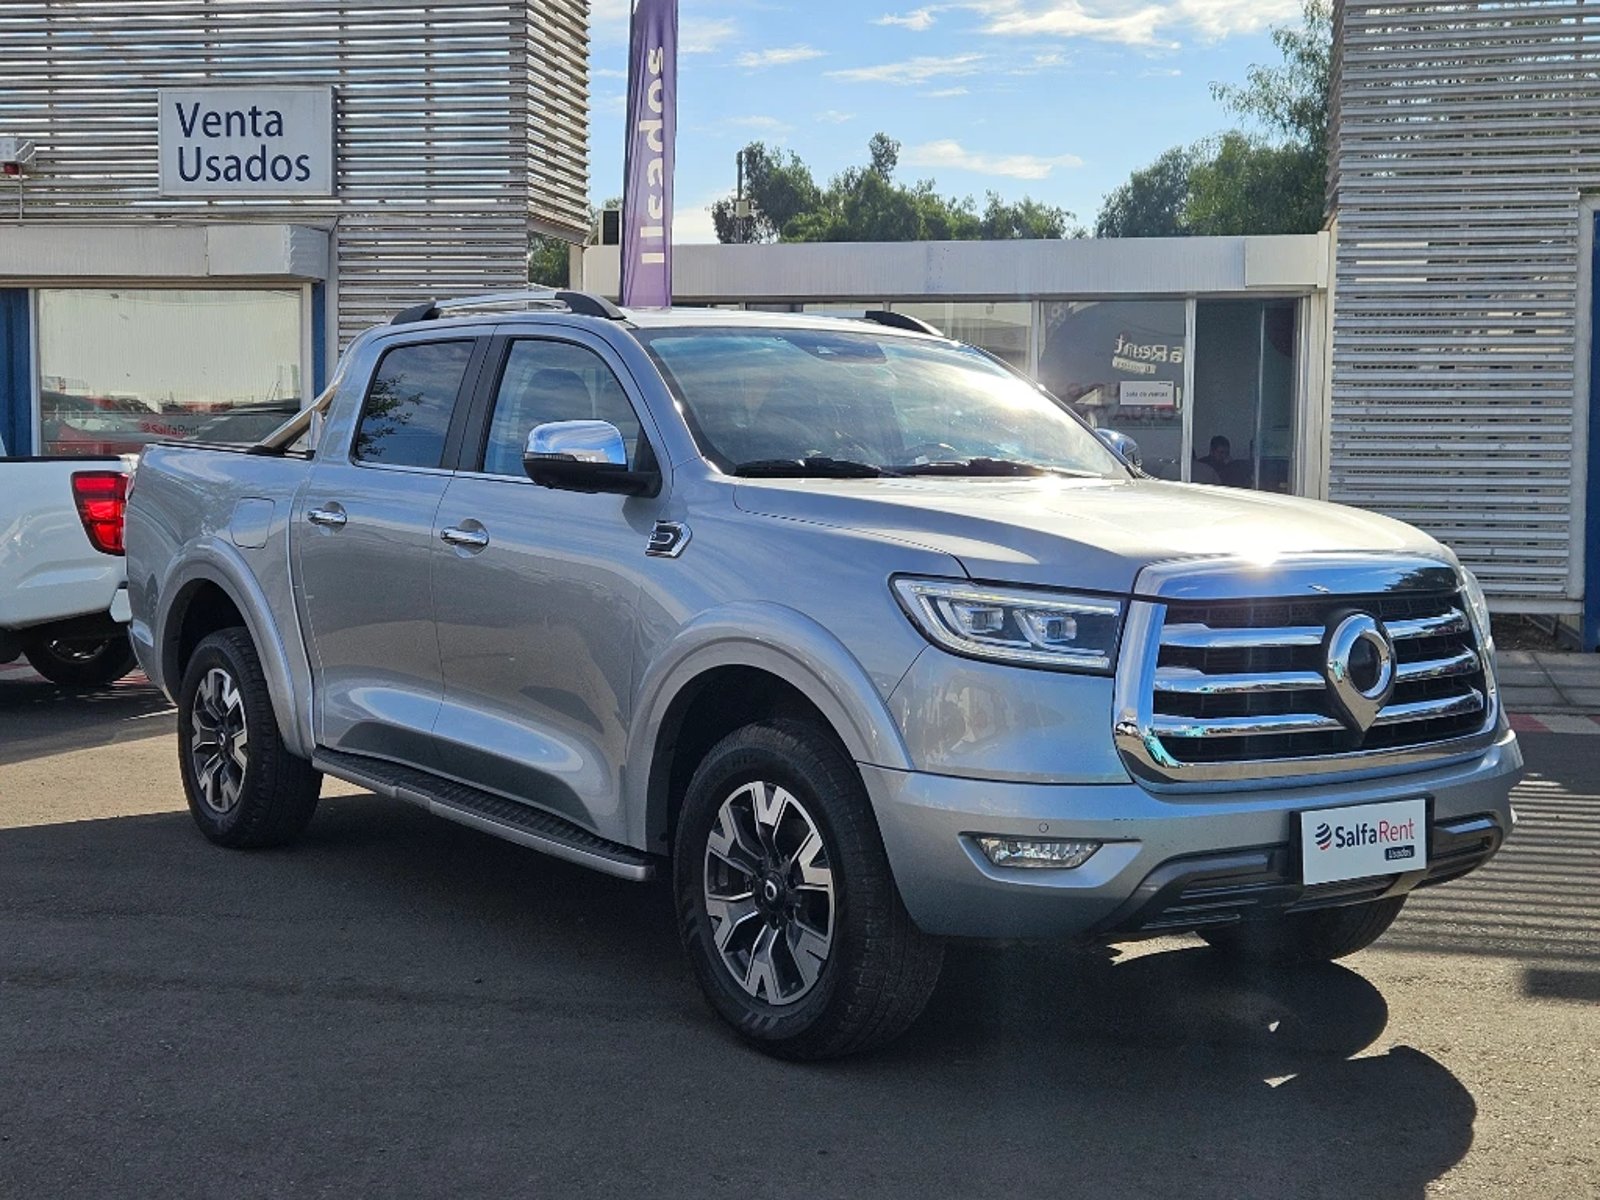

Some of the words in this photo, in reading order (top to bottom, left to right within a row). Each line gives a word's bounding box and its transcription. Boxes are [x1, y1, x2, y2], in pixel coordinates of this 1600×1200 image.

[175, 102, 284, 138] Venta
[177, 144, 311, 182] Usados
[1335, 818, 1415, 848] SalfaRent
